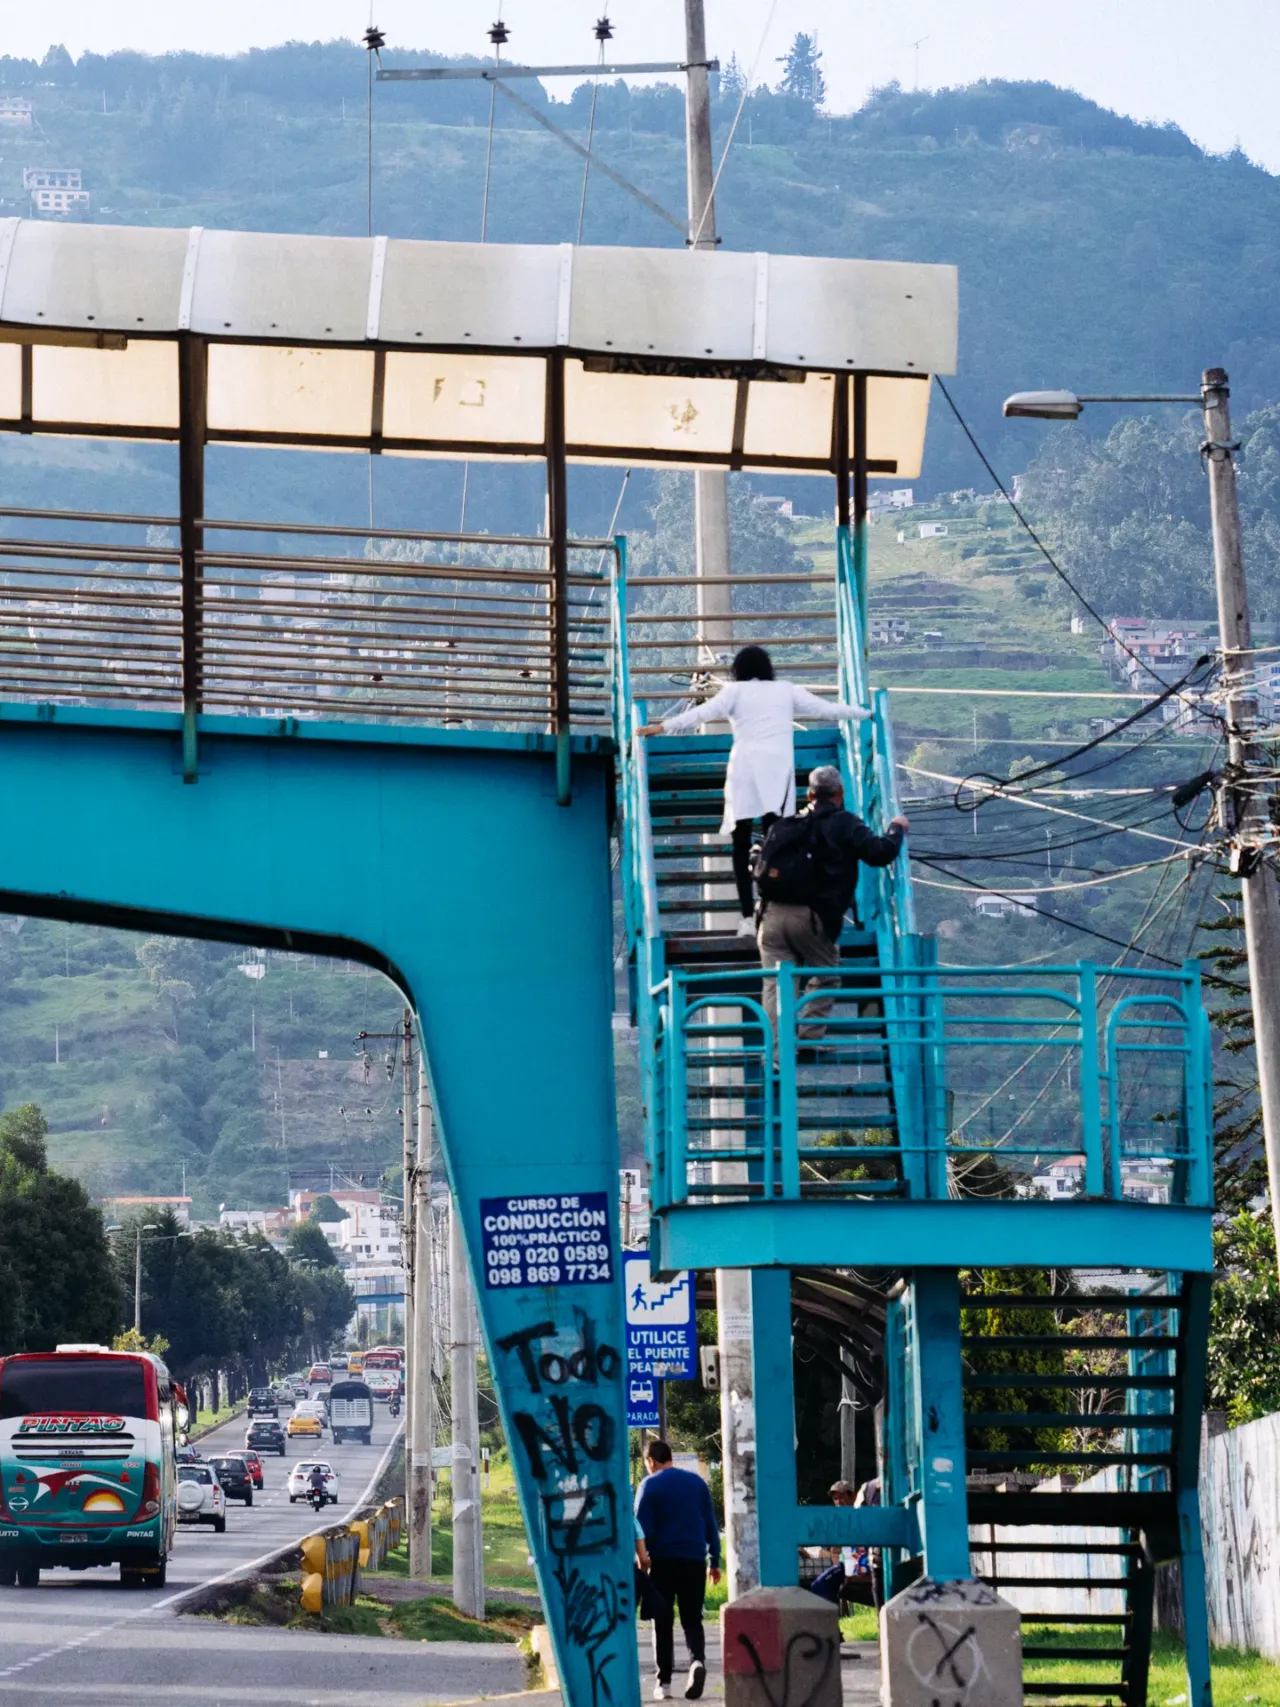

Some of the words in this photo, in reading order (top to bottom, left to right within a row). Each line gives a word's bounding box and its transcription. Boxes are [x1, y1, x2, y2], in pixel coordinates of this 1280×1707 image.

[507, 1198, 557, 1212] CURSO
[561, 1197, 579, 1209] DE
[484, 1207, 606, 1232] CONDUCCIÓN
[487, 1248, 521, 1266] 099
[525, 1246, 559, 1264] 020
[564, 1244, 609, 1262] 0589
[488, 1267, 522, 1285] 098
[527, 1265, 560, 1283] 869
[565, 1263, 610, 1280] 7734
[631, 1330, 687, 1345] UTILICE
[627, 1347, 642, 1359] EL
[645, 1347, 690, 1359] PUENTE
[627, 1411, 660, 1421] PARADA
[126, 1530, 154, 1538] PINTAG
